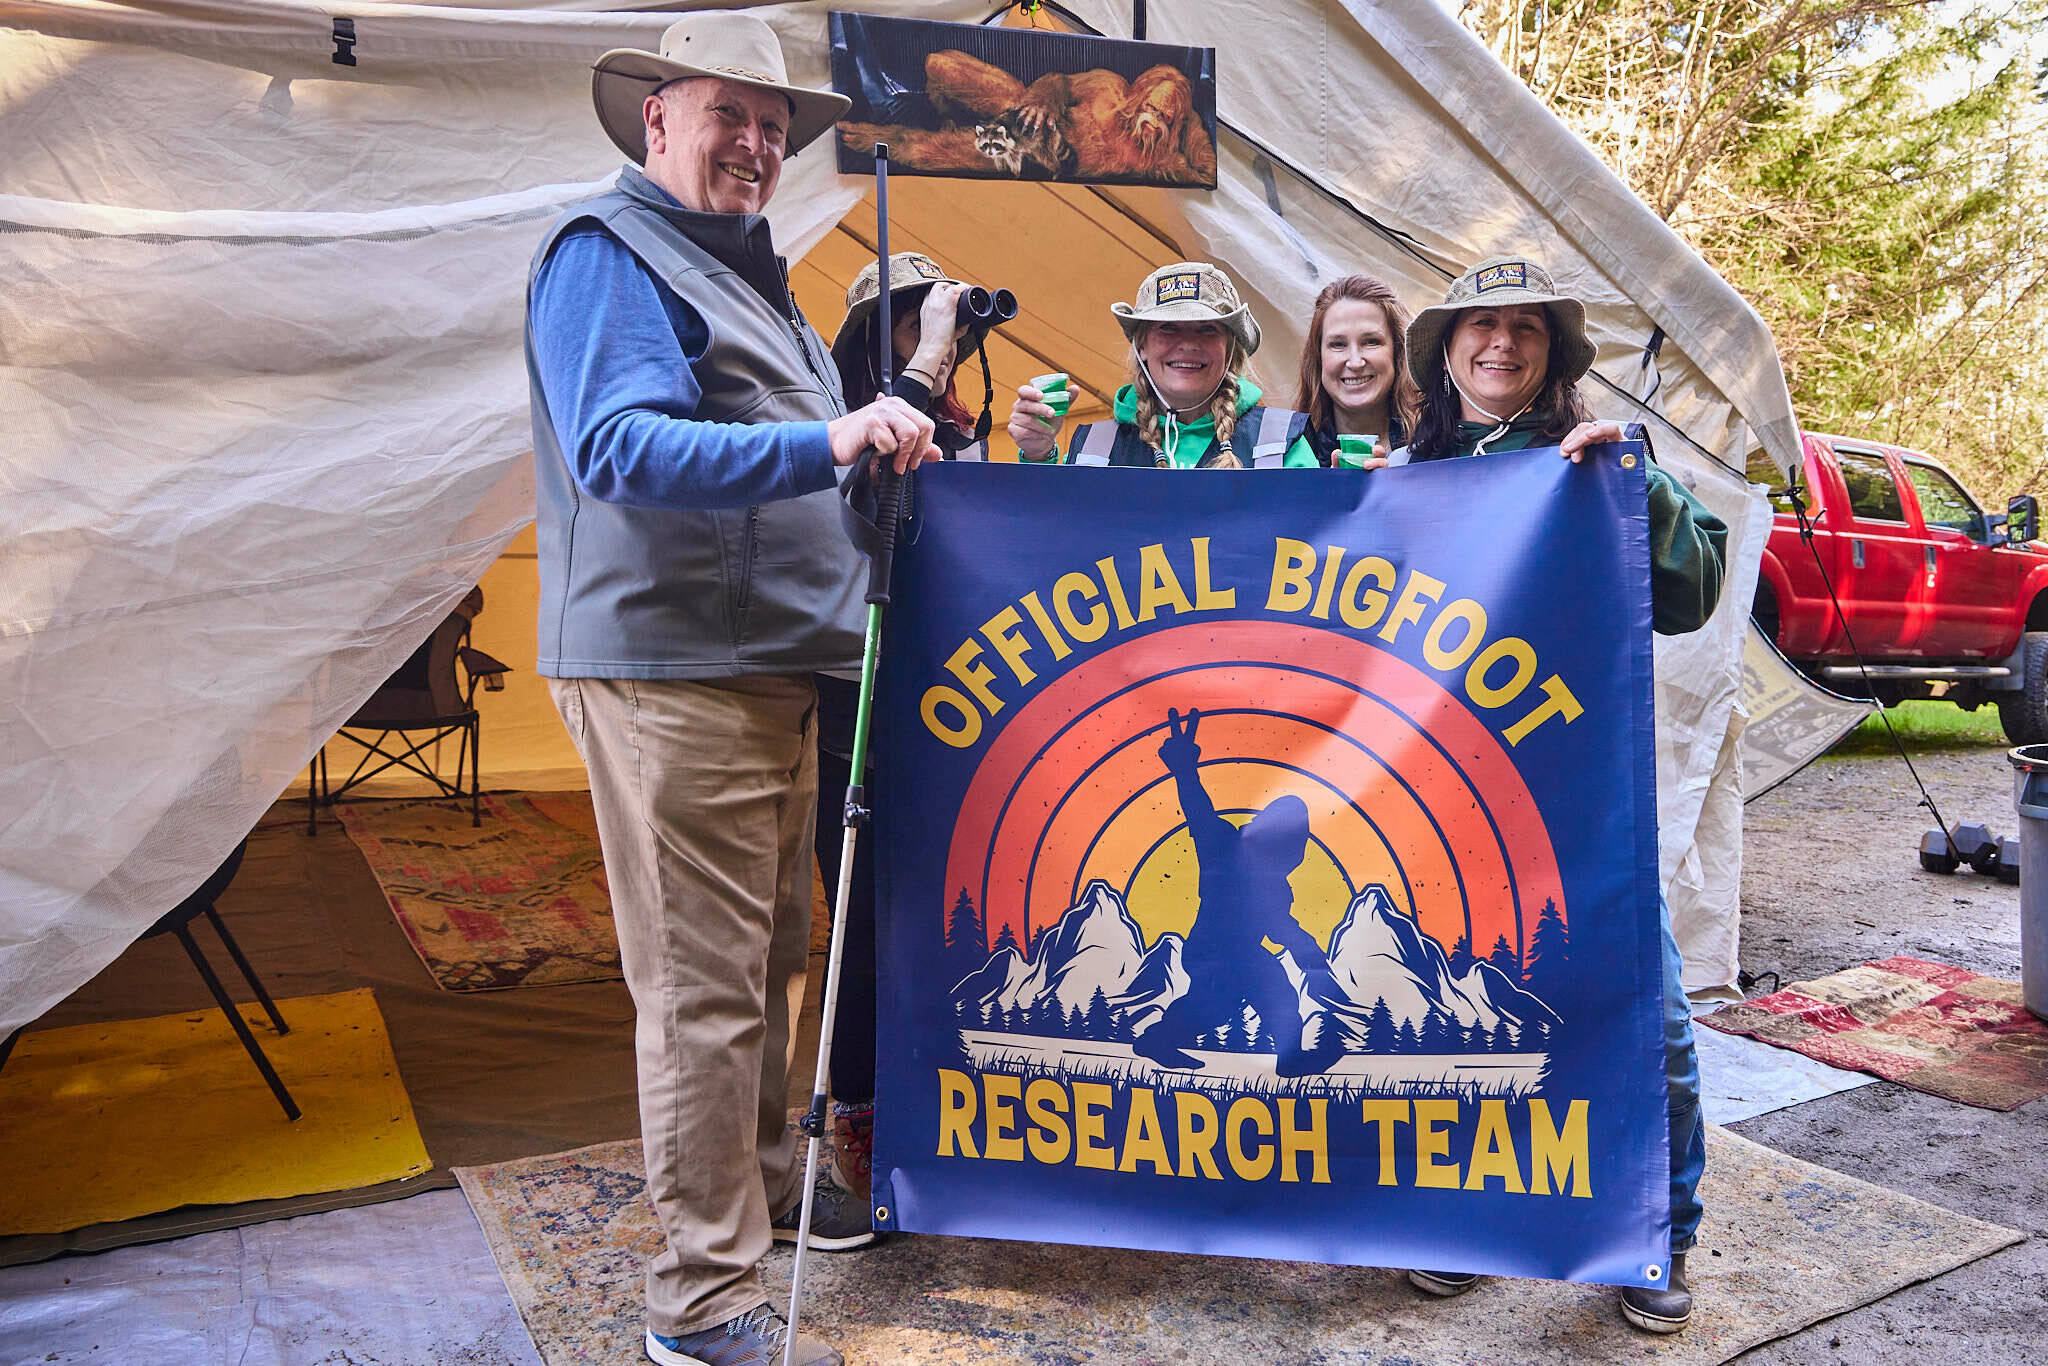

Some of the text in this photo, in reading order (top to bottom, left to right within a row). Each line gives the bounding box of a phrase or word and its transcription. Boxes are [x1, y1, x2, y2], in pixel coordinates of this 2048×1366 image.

[919, 536, 1586, 749] OFFICIAL BIGFOOT
[936, 1067, 1594, 1200] RESEARCH TEAM
